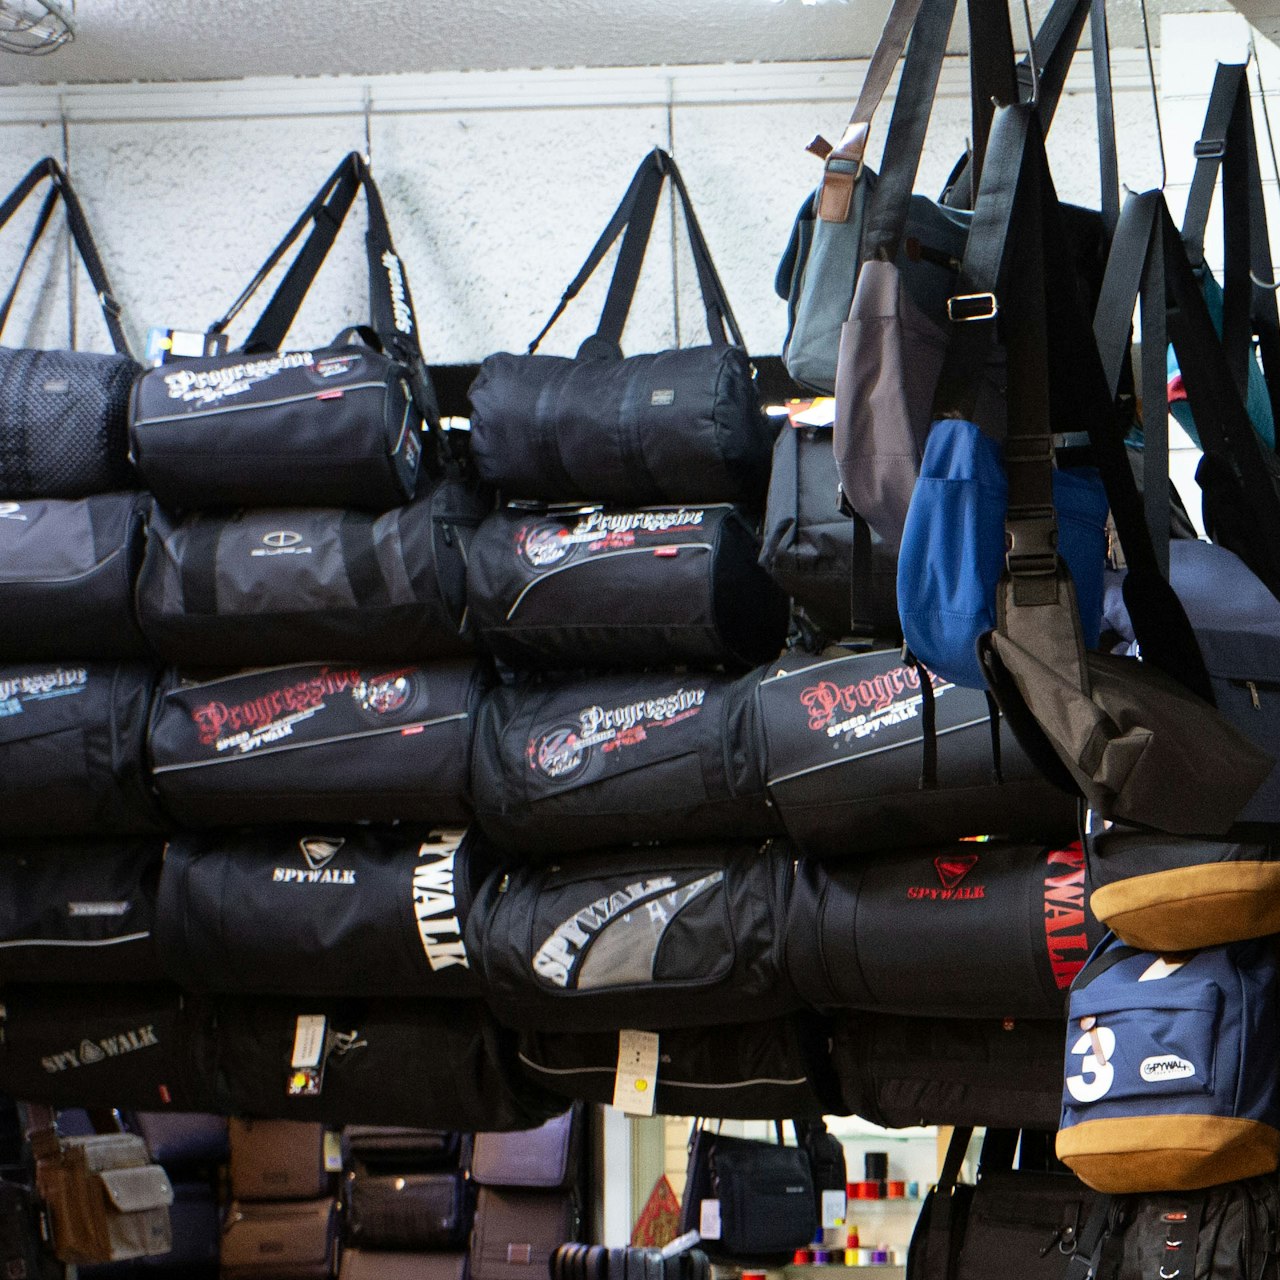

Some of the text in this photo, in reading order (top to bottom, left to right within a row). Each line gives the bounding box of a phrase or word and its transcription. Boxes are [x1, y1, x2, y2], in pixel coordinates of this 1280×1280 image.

[573, 507, 704, 535] Progressive
[192, 667, 361, 744] Progressive
[580, 687, 705, 738] Progressive
[854, 703, 919, 739] SPYWALK
[826, 714, 867, 738] SPEED
[272, 867, 357, 884] SPYWALK
[907, 885, 986, 900] SPYWALK
[532, 876, 677, 987] SPYWALK
[100, 1025, 158, 1058] WALK
[1066, 1026, 1115, 1102] 3
